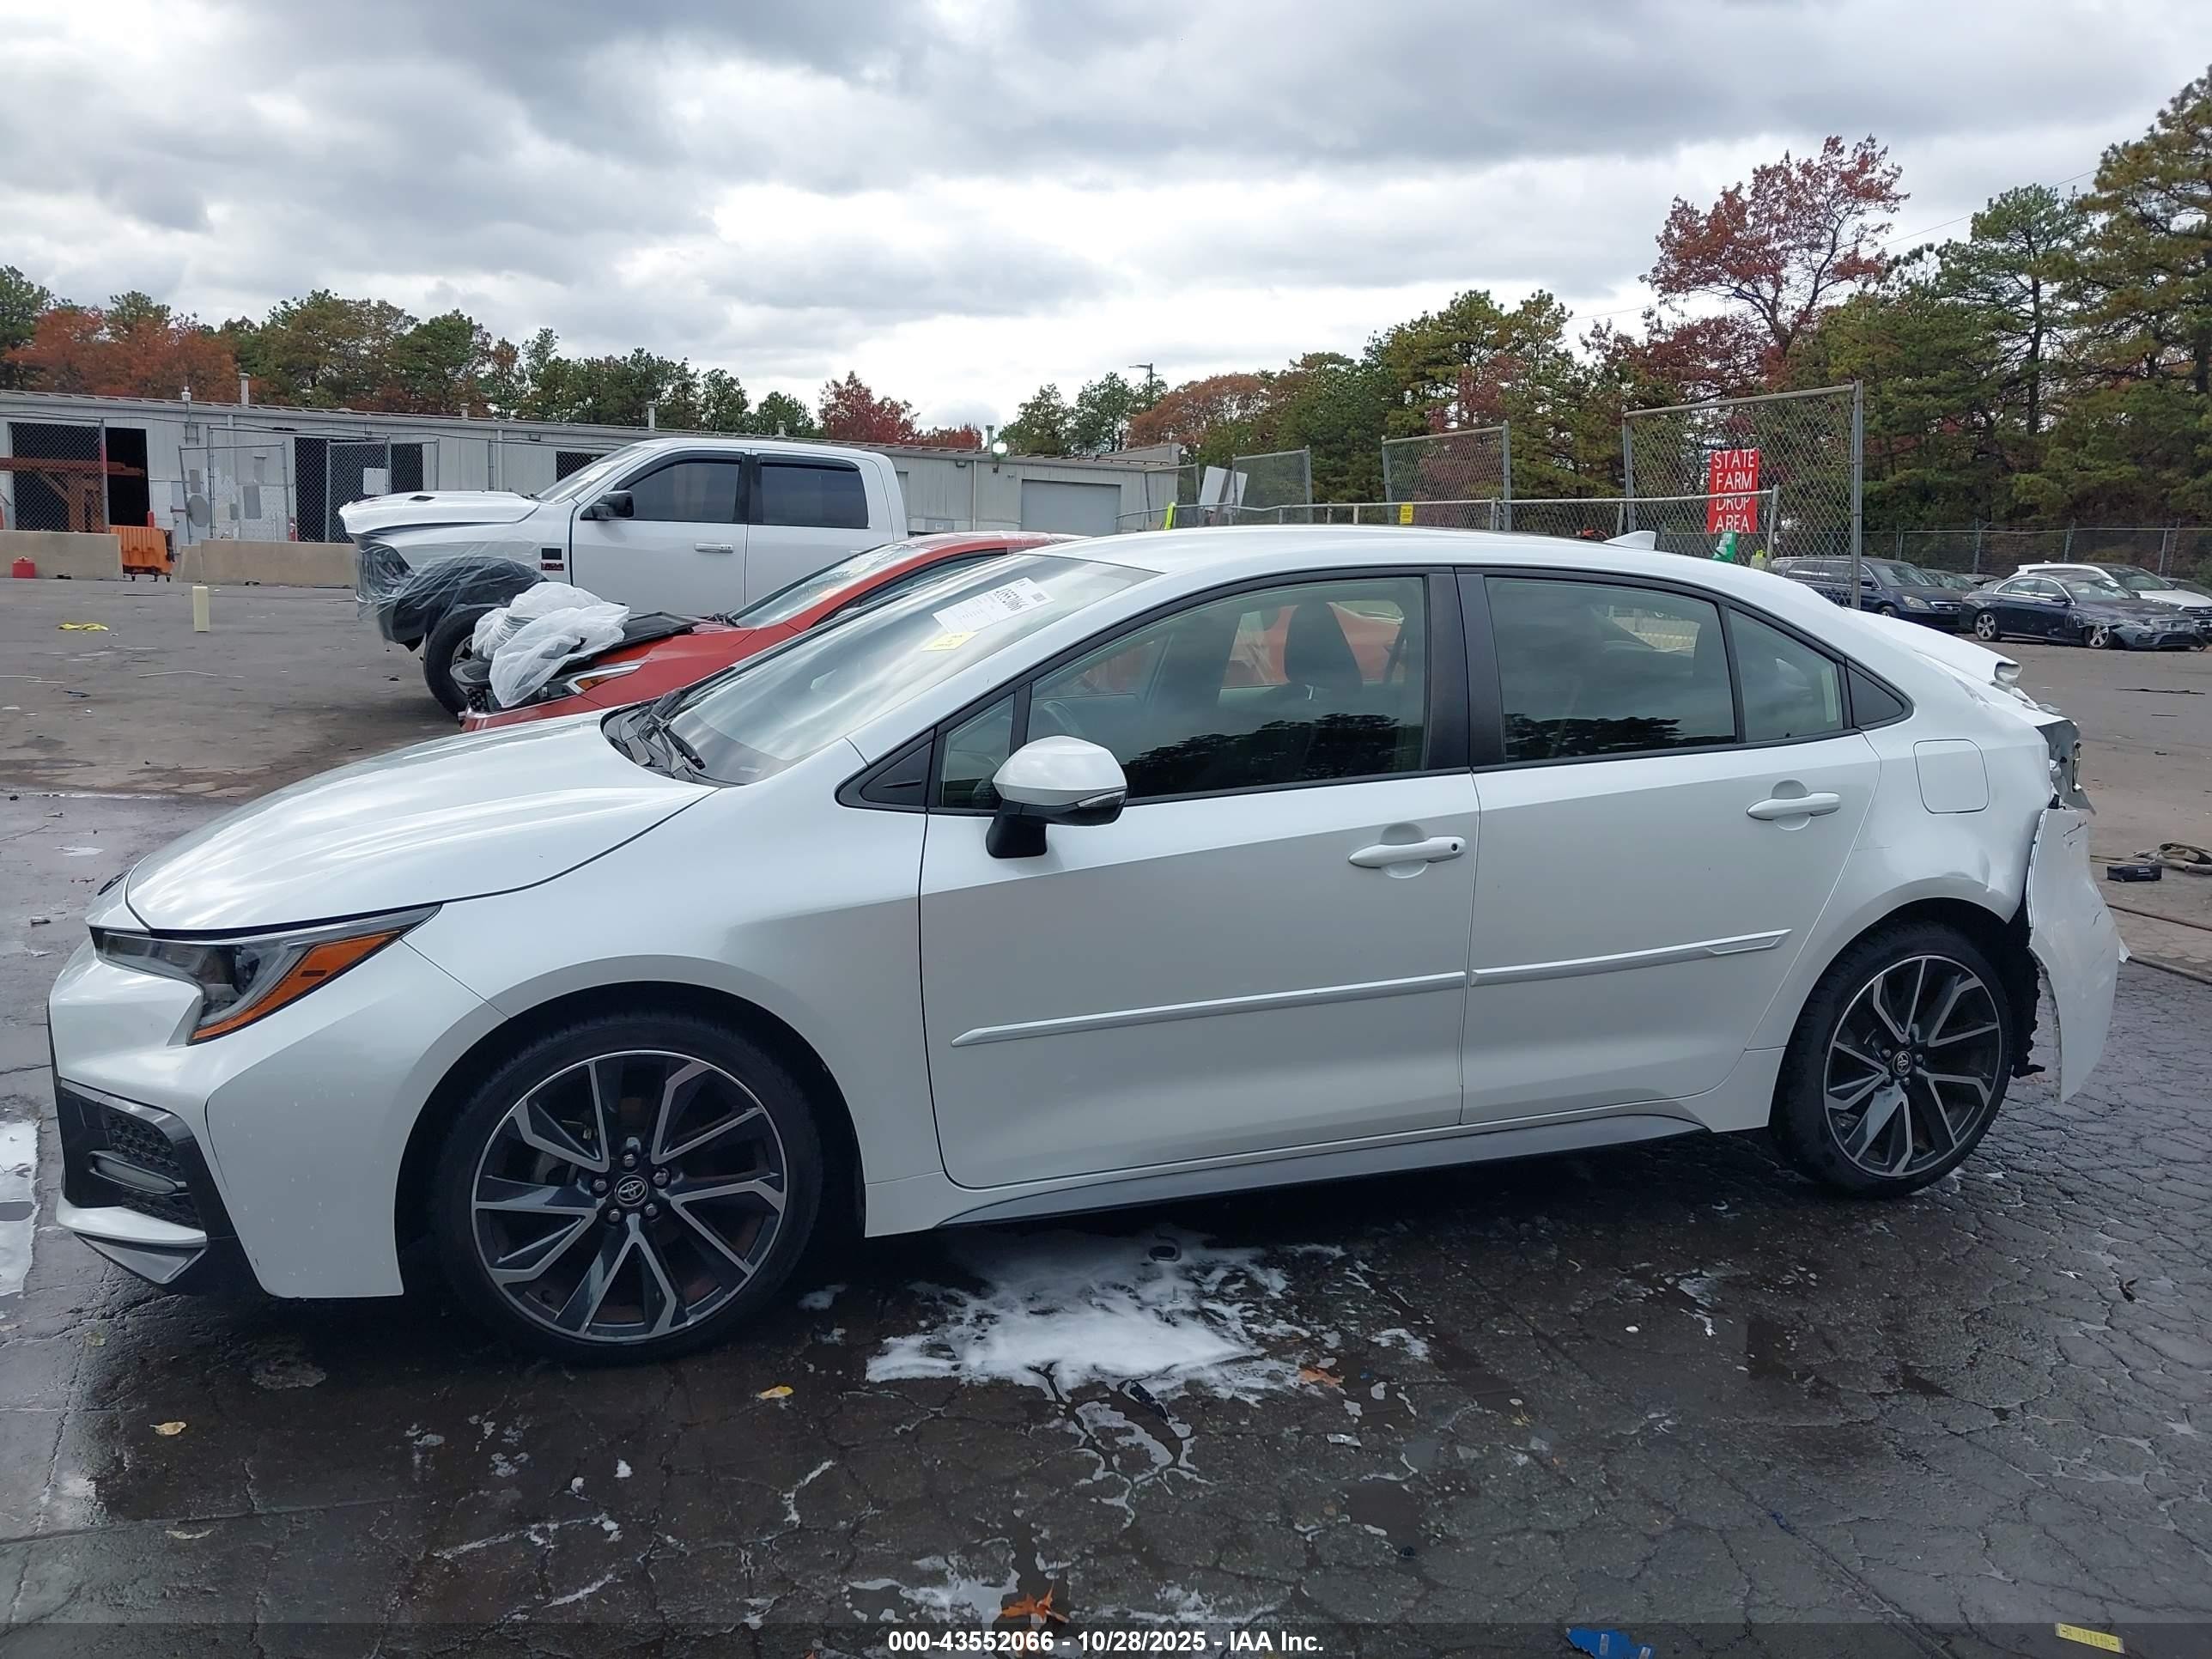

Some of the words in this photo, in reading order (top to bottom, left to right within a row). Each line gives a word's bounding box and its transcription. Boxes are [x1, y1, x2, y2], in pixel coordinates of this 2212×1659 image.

[1714, 449, 1755, 470] STATE
[1716, 471, 1753, 490] FARM
[1716, 493, 1751, 512] DROP
[1714, 514, 1750, 533] AREA
